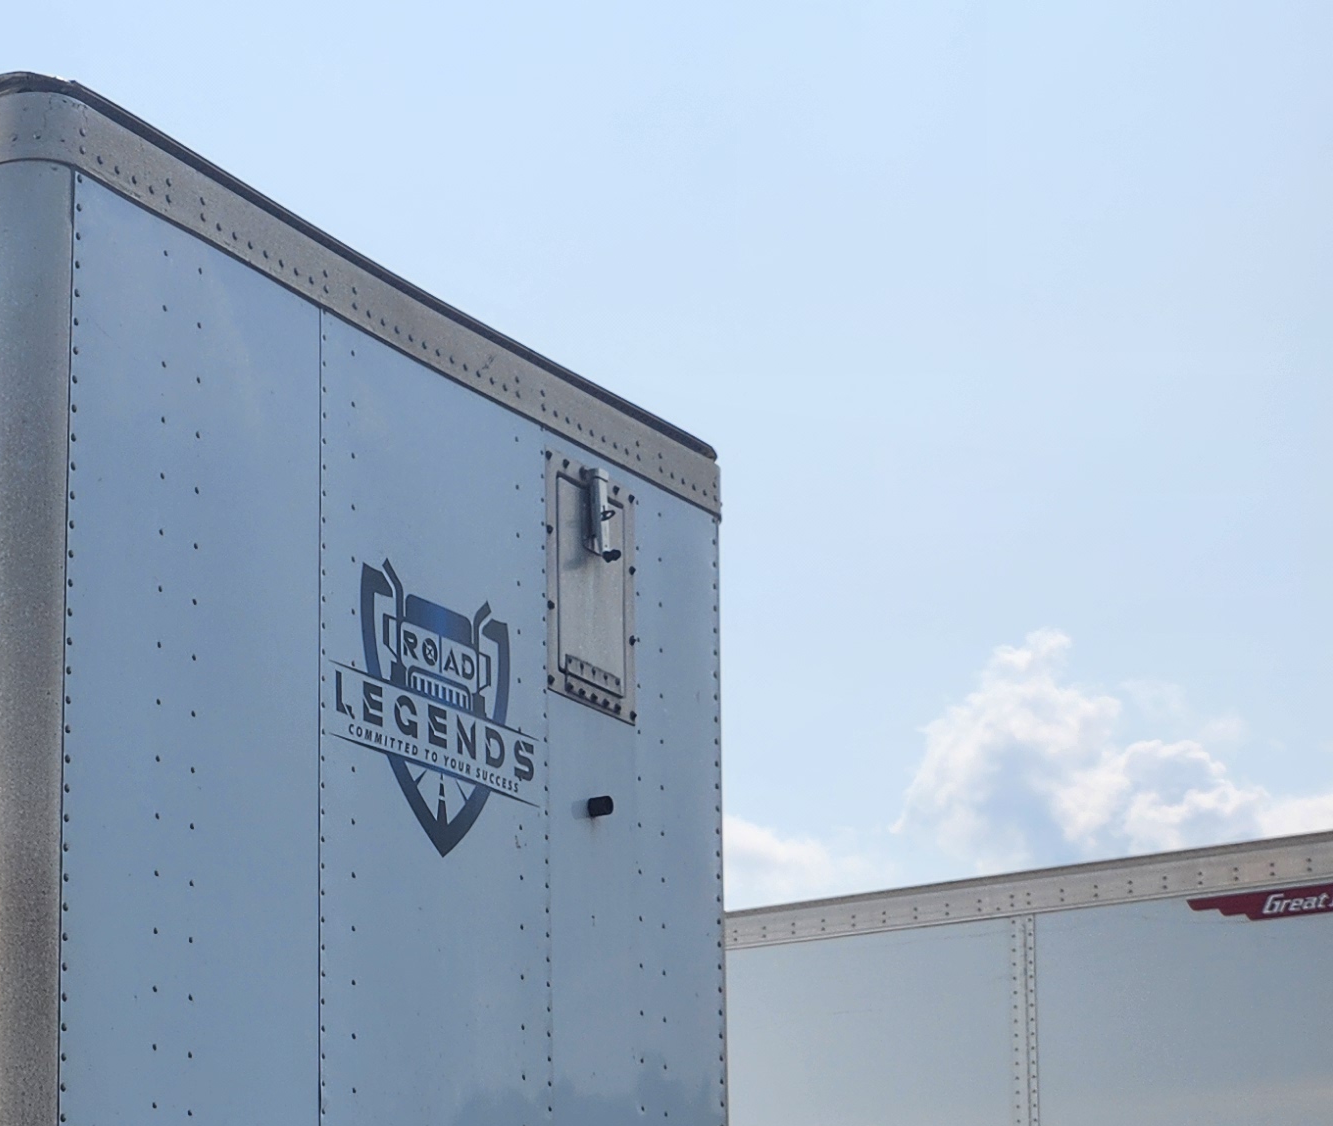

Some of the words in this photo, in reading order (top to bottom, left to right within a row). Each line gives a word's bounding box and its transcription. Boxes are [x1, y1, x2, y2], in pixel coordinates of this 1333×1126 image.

[403, 629, 476, 681] ROAD
[335, 670, 534, 781] LEGENDS
[348, 723, 419, 756] COMMITTED
[424, 748, 439, 763] TO
[444, 755, 472, 777] YOUR
[476, 769, 520, 794] SUCCESS
[1262, 892, 1329, 914] Great
